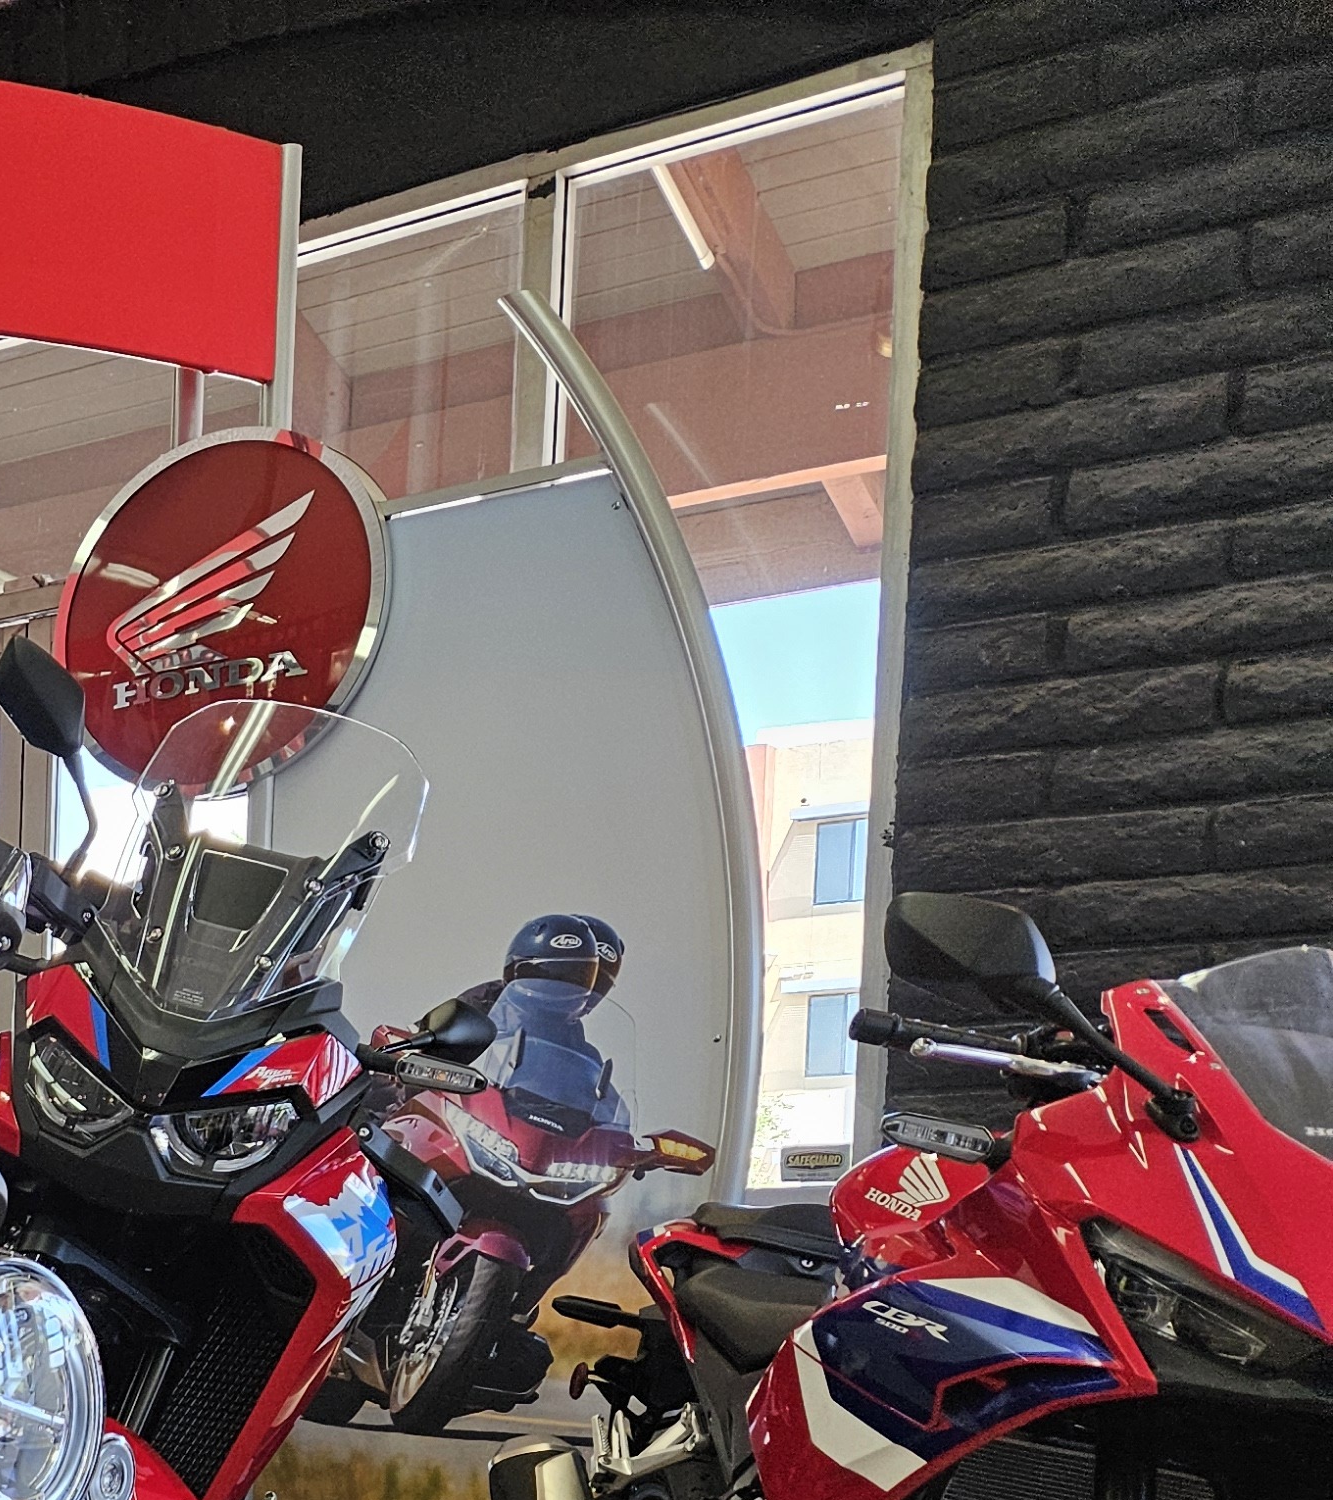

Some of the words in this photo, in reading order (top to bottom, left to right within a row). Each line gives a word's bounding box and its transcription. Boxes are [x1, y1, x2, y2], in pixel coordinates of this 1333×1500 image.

[112, 650, 309, 710] HONDA
[528, 1114, 564, 1131] HONDA
[788, 1154, 842, 1166] SAFEGUARD
[864, 1186, 922, 1222] HONDA
[861, 1300, 950, 1344] CBR
